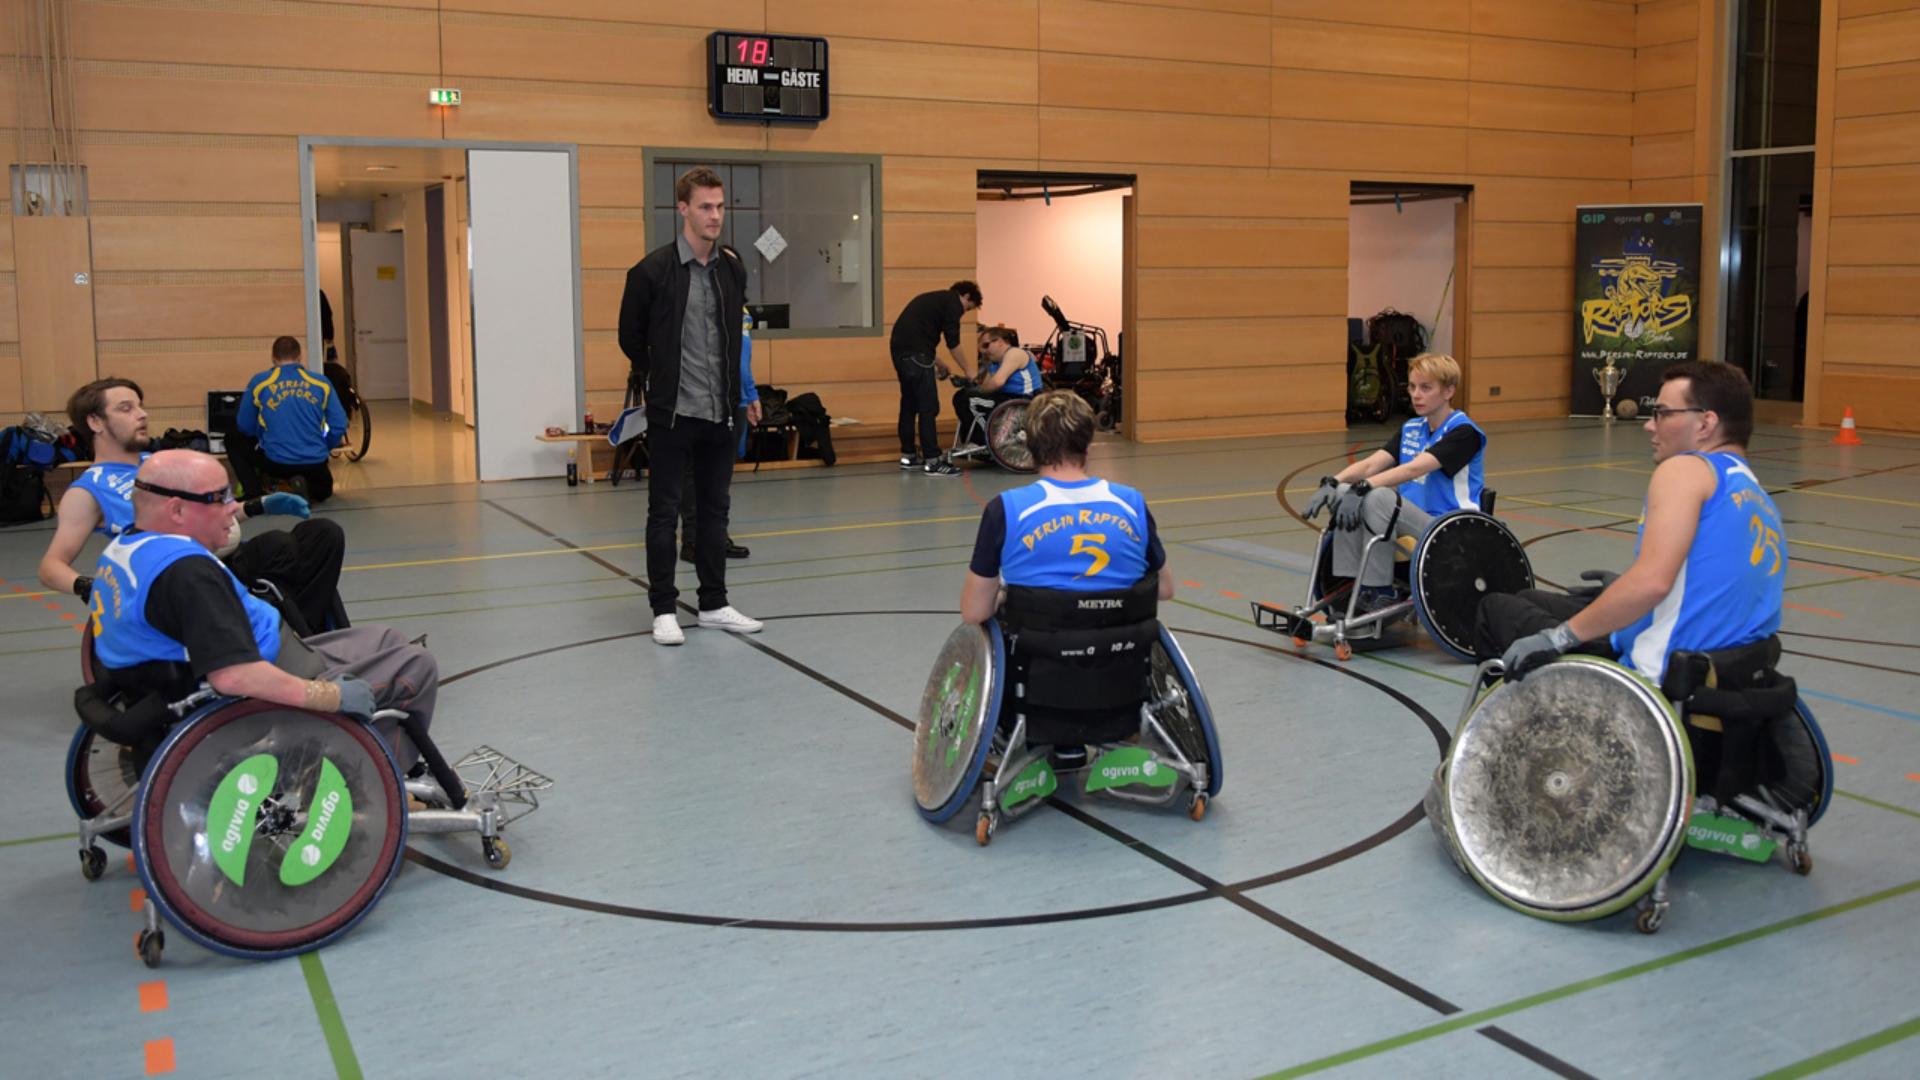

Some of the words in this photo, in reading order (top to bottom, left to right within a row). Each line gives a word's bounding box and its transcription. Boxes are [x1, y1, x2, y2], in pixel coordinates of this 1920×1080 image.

[726, 67, 758, 84] HEIM
[781, 67, 820, 88] GÄSTE
[1582, 214, 1605, 224] GIP
[1022, 514, 1074, 551] BERLIN
[1749, 513, 1781, 577] 25
[1069, 533, 1111, 582] 5
[1078, 599, 1123, 609] MEYRA
[1102, 766, 1140, 780] agivia
[221, 798, 249, 853] agivia
[311, 790, 340, 842] agivia
[1687, 824, 1738, 845] agivia
